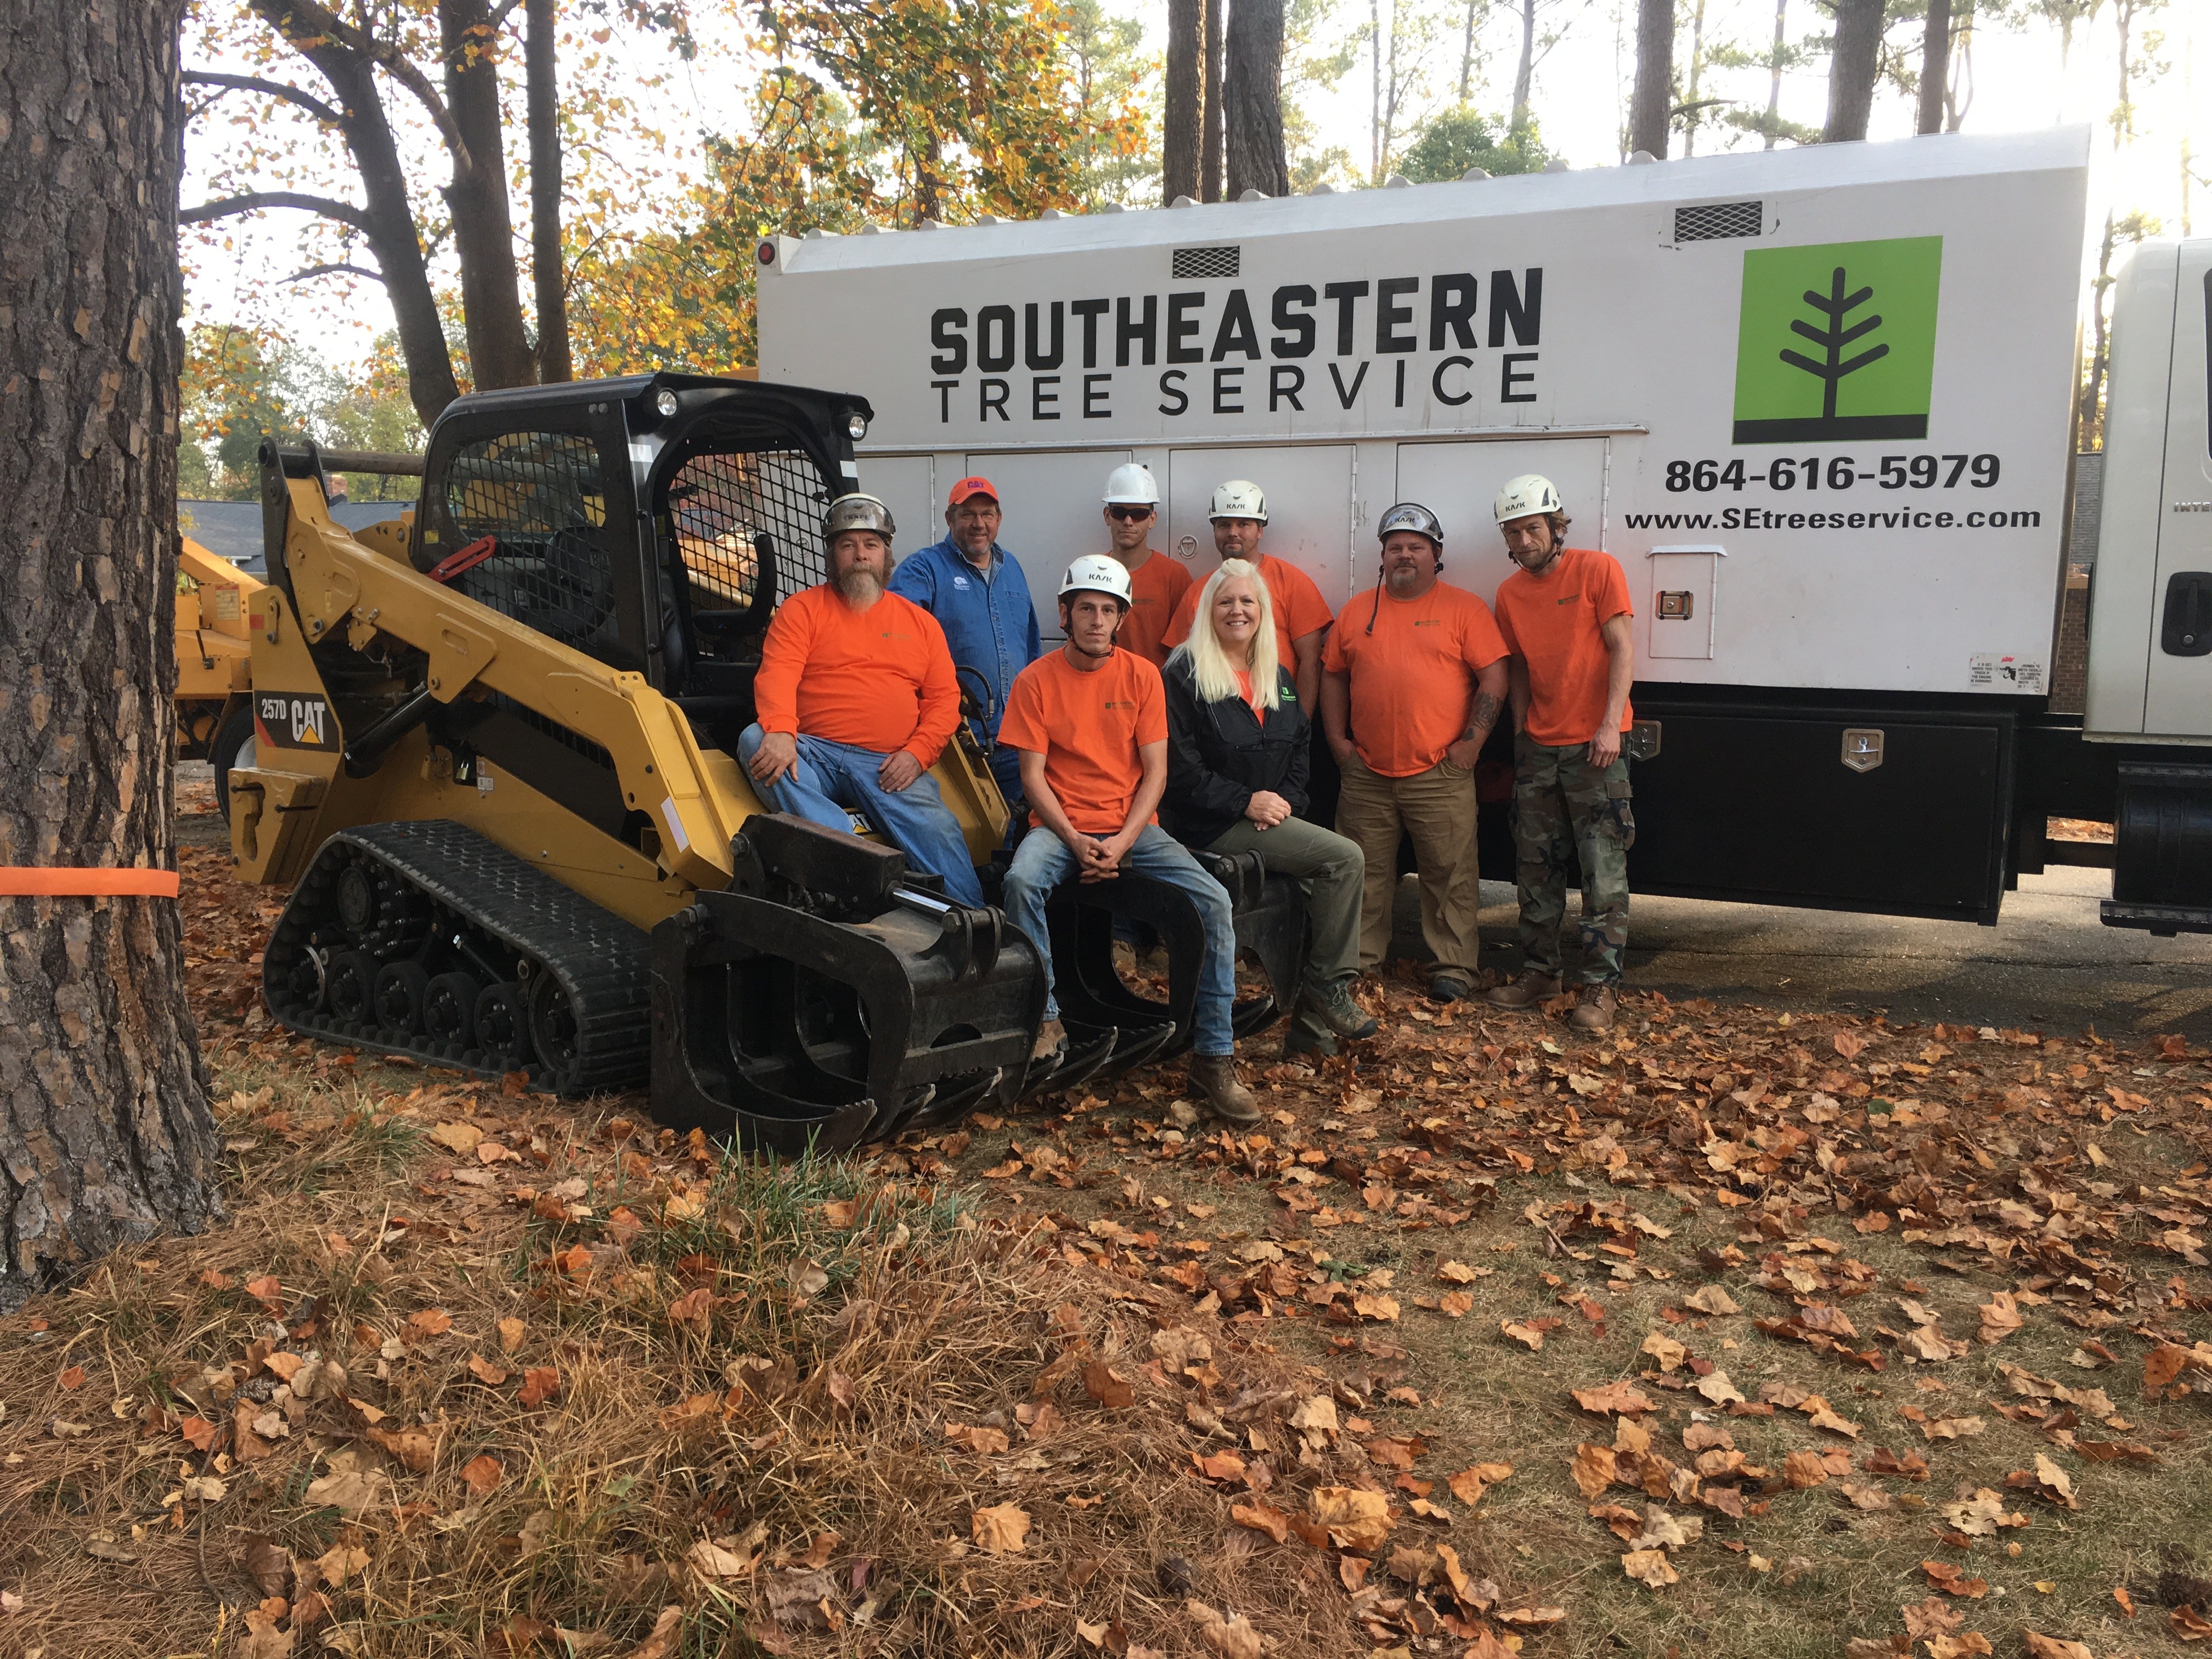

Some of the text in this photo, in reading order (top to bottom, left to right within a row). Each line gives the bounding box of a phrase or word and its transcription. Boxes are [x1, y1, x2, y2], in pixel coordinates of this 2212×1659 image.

[931, 267, 1543, 375] SOUTHEASTERN
[930, 352, 1539, 424] TREE SERVICE
[1665, 454, 2000, 493] 864-616-5979
[1505, 501, 1526, 512] KASK
[1624, 506, 2041, 529] www.SEtreeservice.com
[2174, 501, 2212, 512] INTE
[1088, 574, 1113, 583] KASK
[262, 698, 325, 744] 257D CAT
[849, 813, 872, 832] AT
